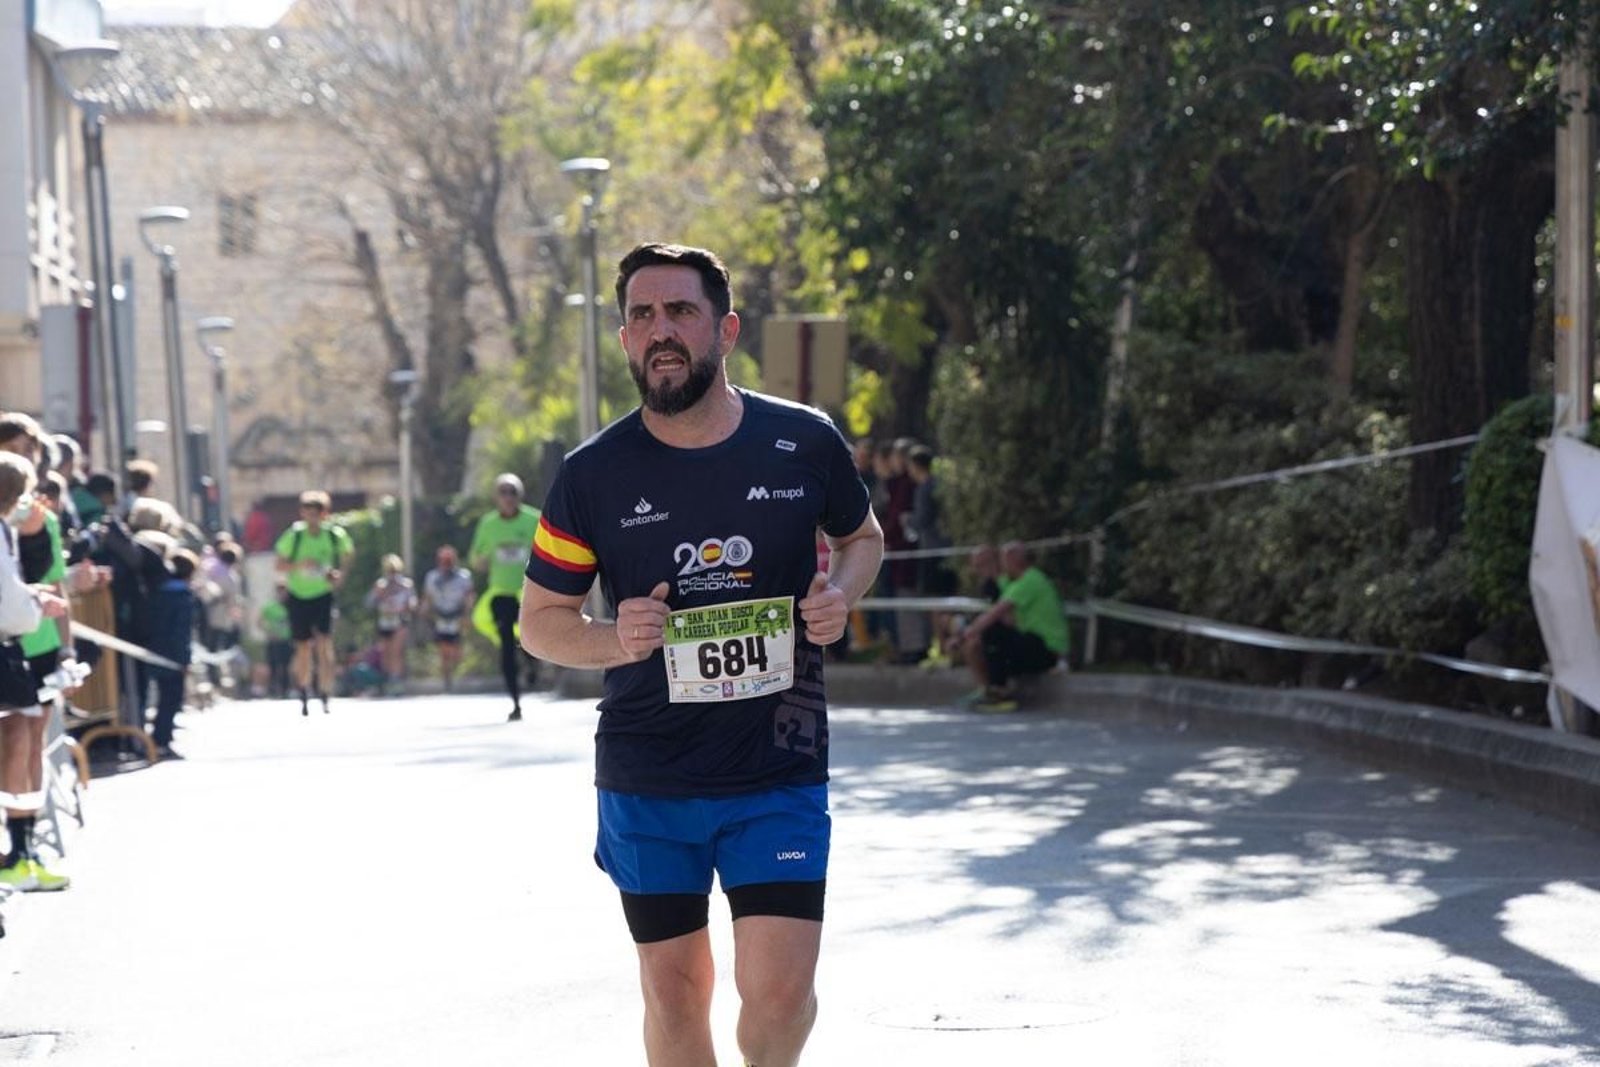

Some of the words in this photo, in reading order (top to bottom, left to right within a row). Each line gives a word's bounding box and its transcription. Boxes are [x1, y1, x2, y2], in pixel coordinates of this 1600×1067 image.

[773, 485, 804, 501] mupol
[620, 511, 670, 528] Santander
[674, 535, 753, 576] 200
[679, 580, 751, 596] NACIONAL
[687, 611, 704, 625] SAN
[707, 608, 729, 622] JUAN
[684, 622, 717, 638] CARRERA
[719, 618, 749, 636] POPULAR
[698, 636, 768, 680] 684
